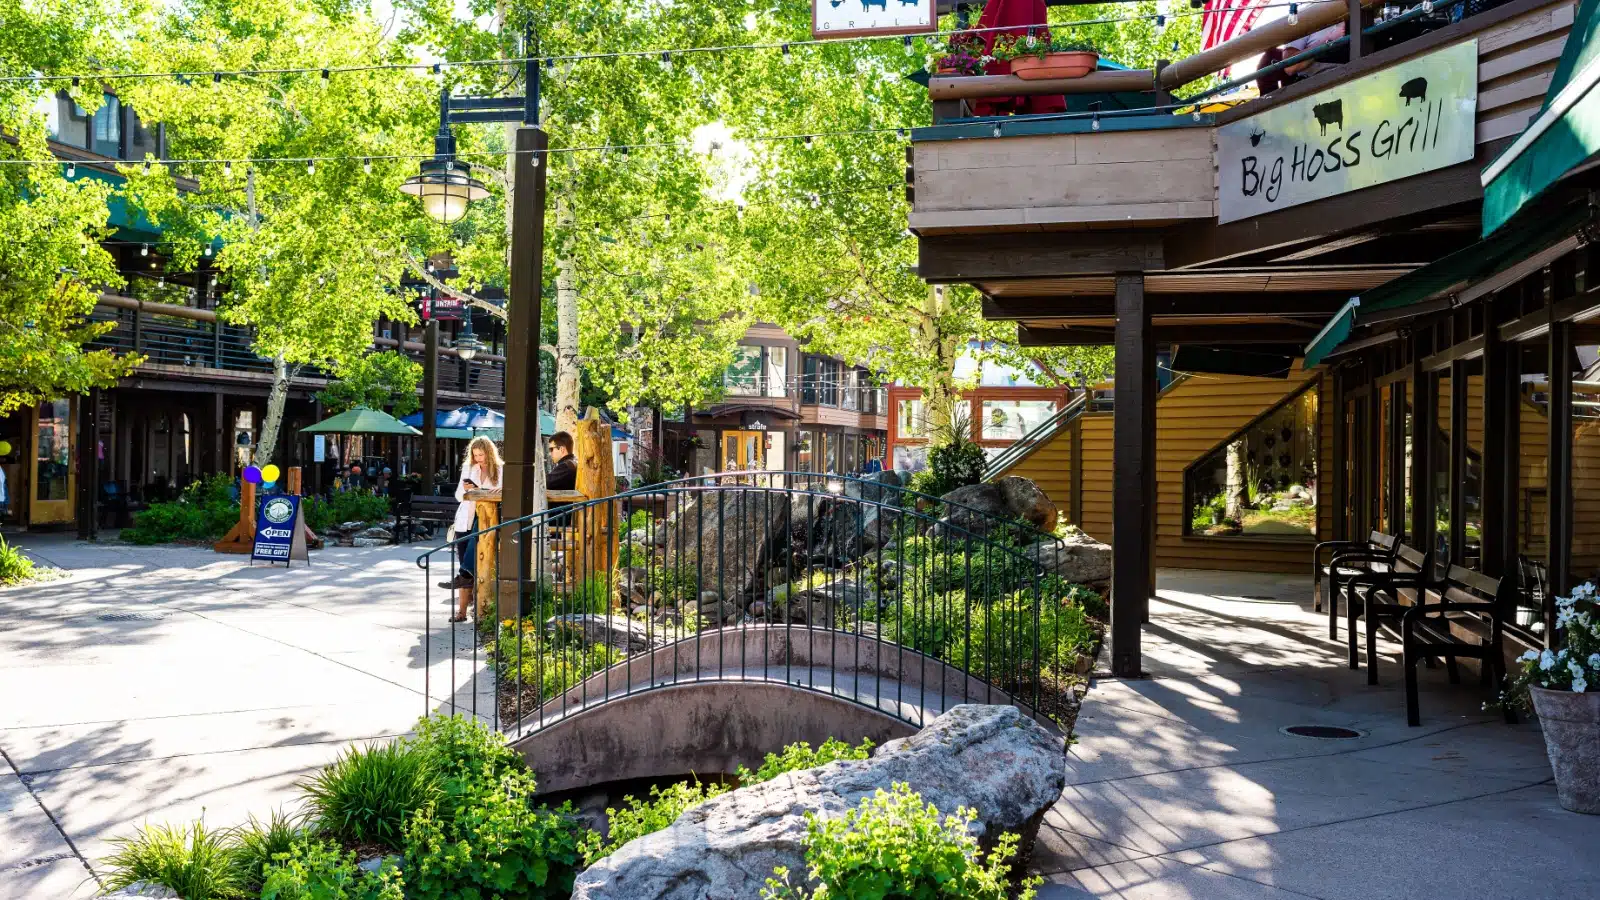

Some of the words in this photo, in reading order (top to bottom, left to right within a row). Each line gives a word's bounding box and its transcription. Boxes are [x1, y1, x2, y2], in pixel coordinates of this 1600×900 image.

[1241, 155, 1284, 202] Big
[1371, 97, 1442, 160] Grill
[265, 529, 289, 537] OPEN
